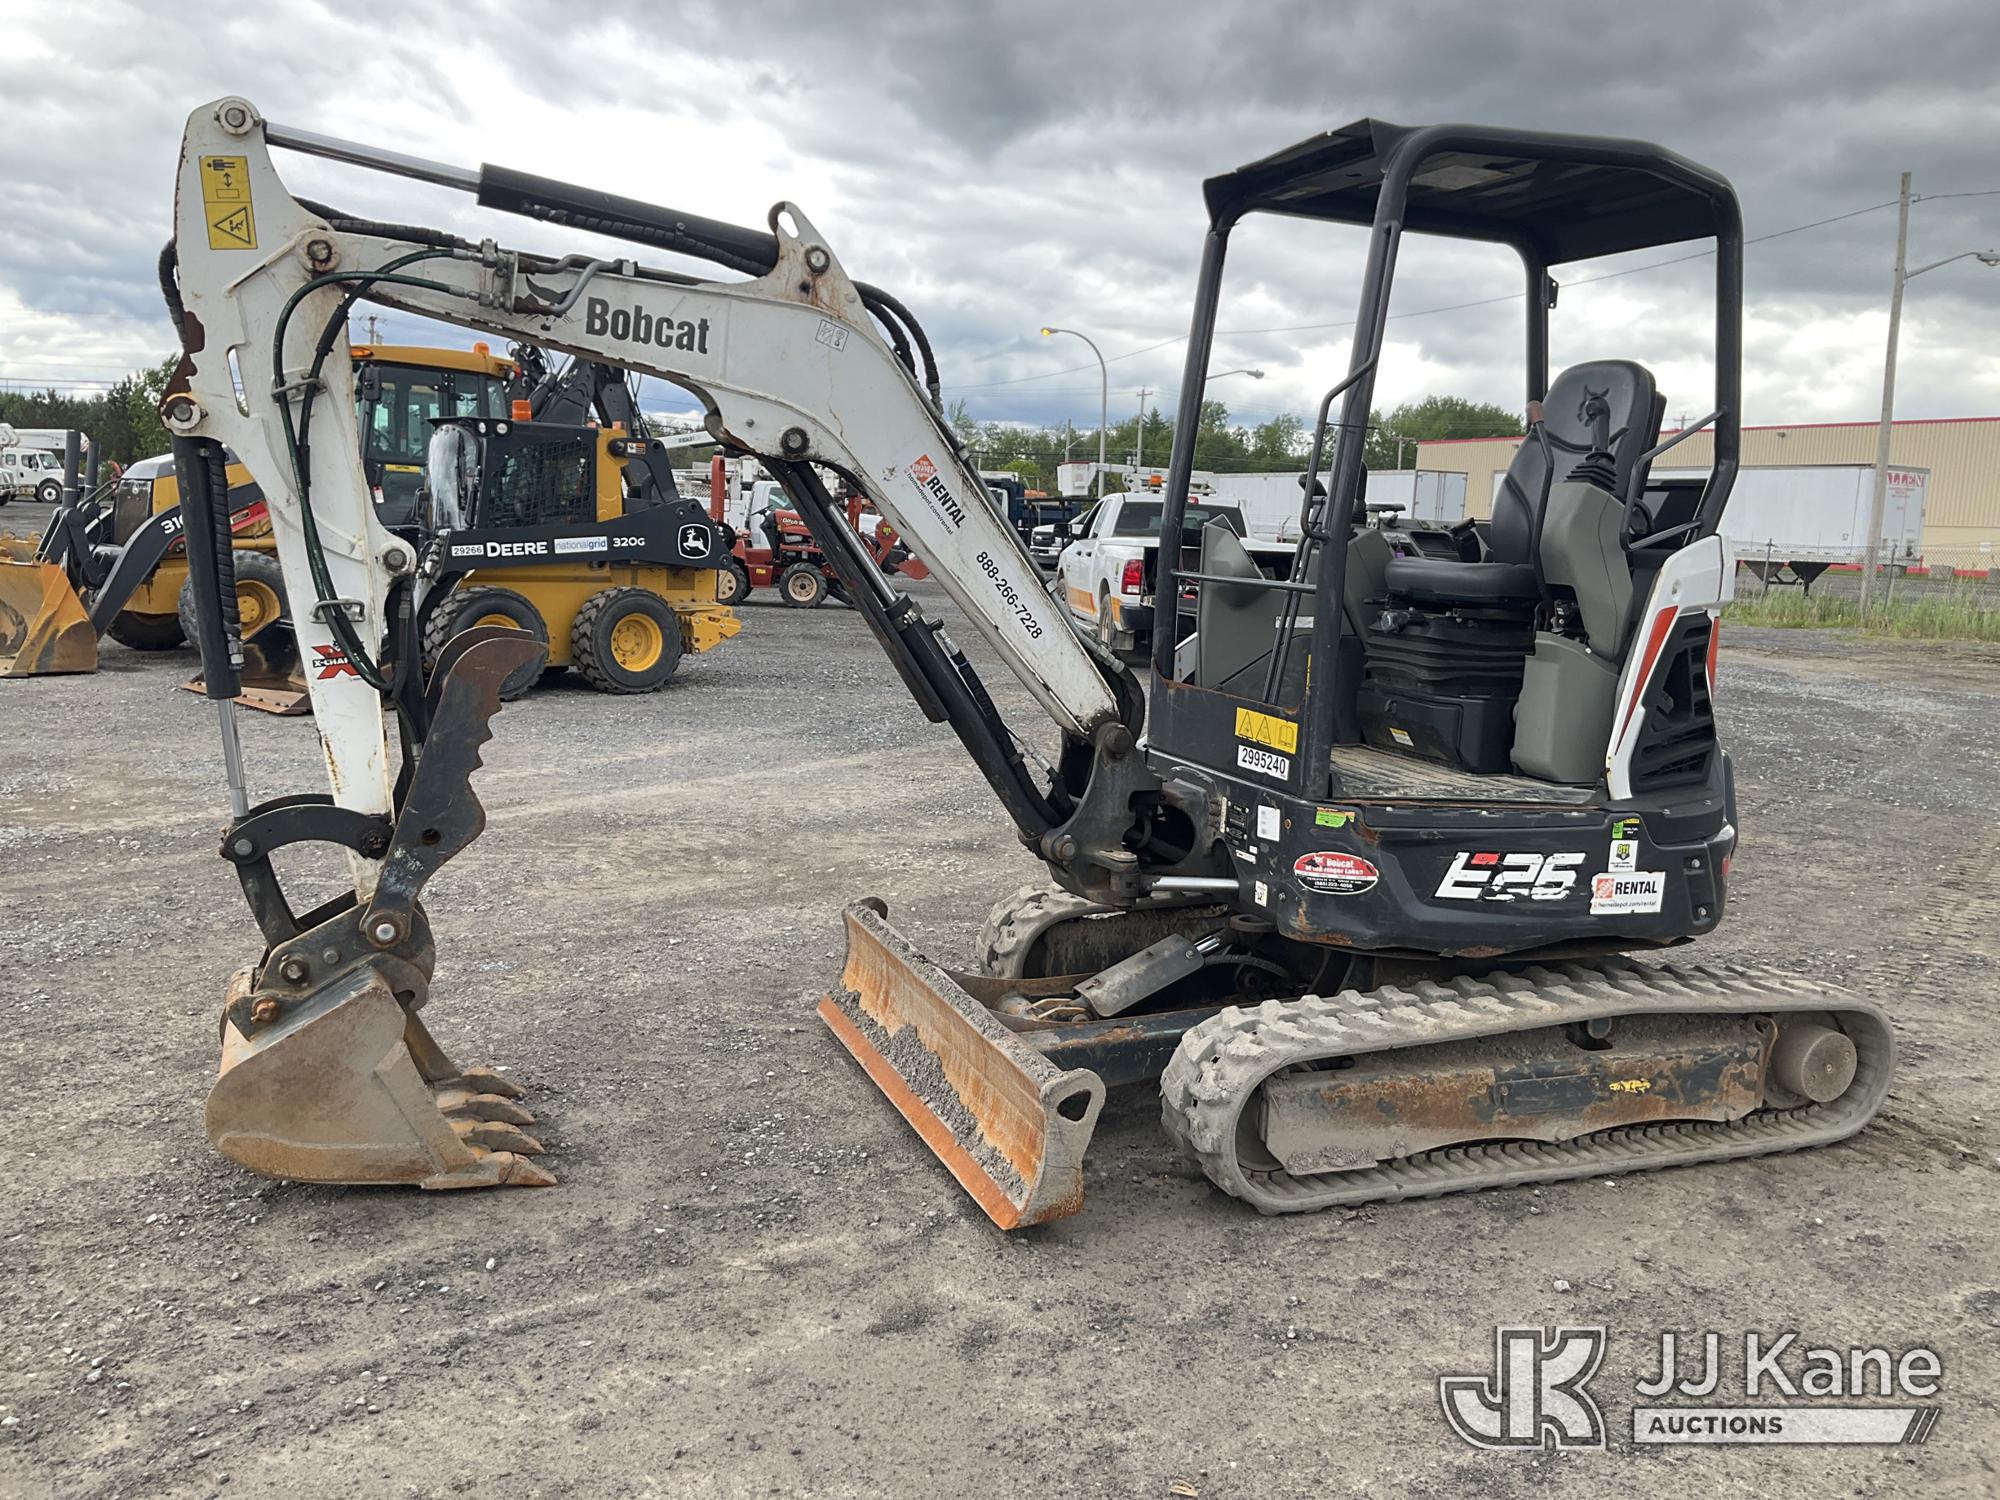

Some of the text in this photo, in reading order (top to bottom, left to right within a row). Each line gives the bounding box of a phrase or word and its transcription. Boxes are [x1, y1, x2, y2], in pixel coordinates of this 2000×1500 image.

[585, 296, 710, 354] Bobcat
[906, 472, 954, 536] homedepot.com/rental
[926, 475, 967, 529] RENTAL
[486, 541, 548, 558] DEERE
[555, 537, 607, 552] nationalgrid
[612, 536, 646, 547] 320G
[453, 545, 483, 555] 29266
[975, 551, 1043, 639] 888-266-7228
[314, 657, 349, 667] X-CHA
[1241, 747, 1286, 774] 2995240
[1326, 858, 1354, 868] Bobcat
[1614, 880, 1658, 895] RENTAL
